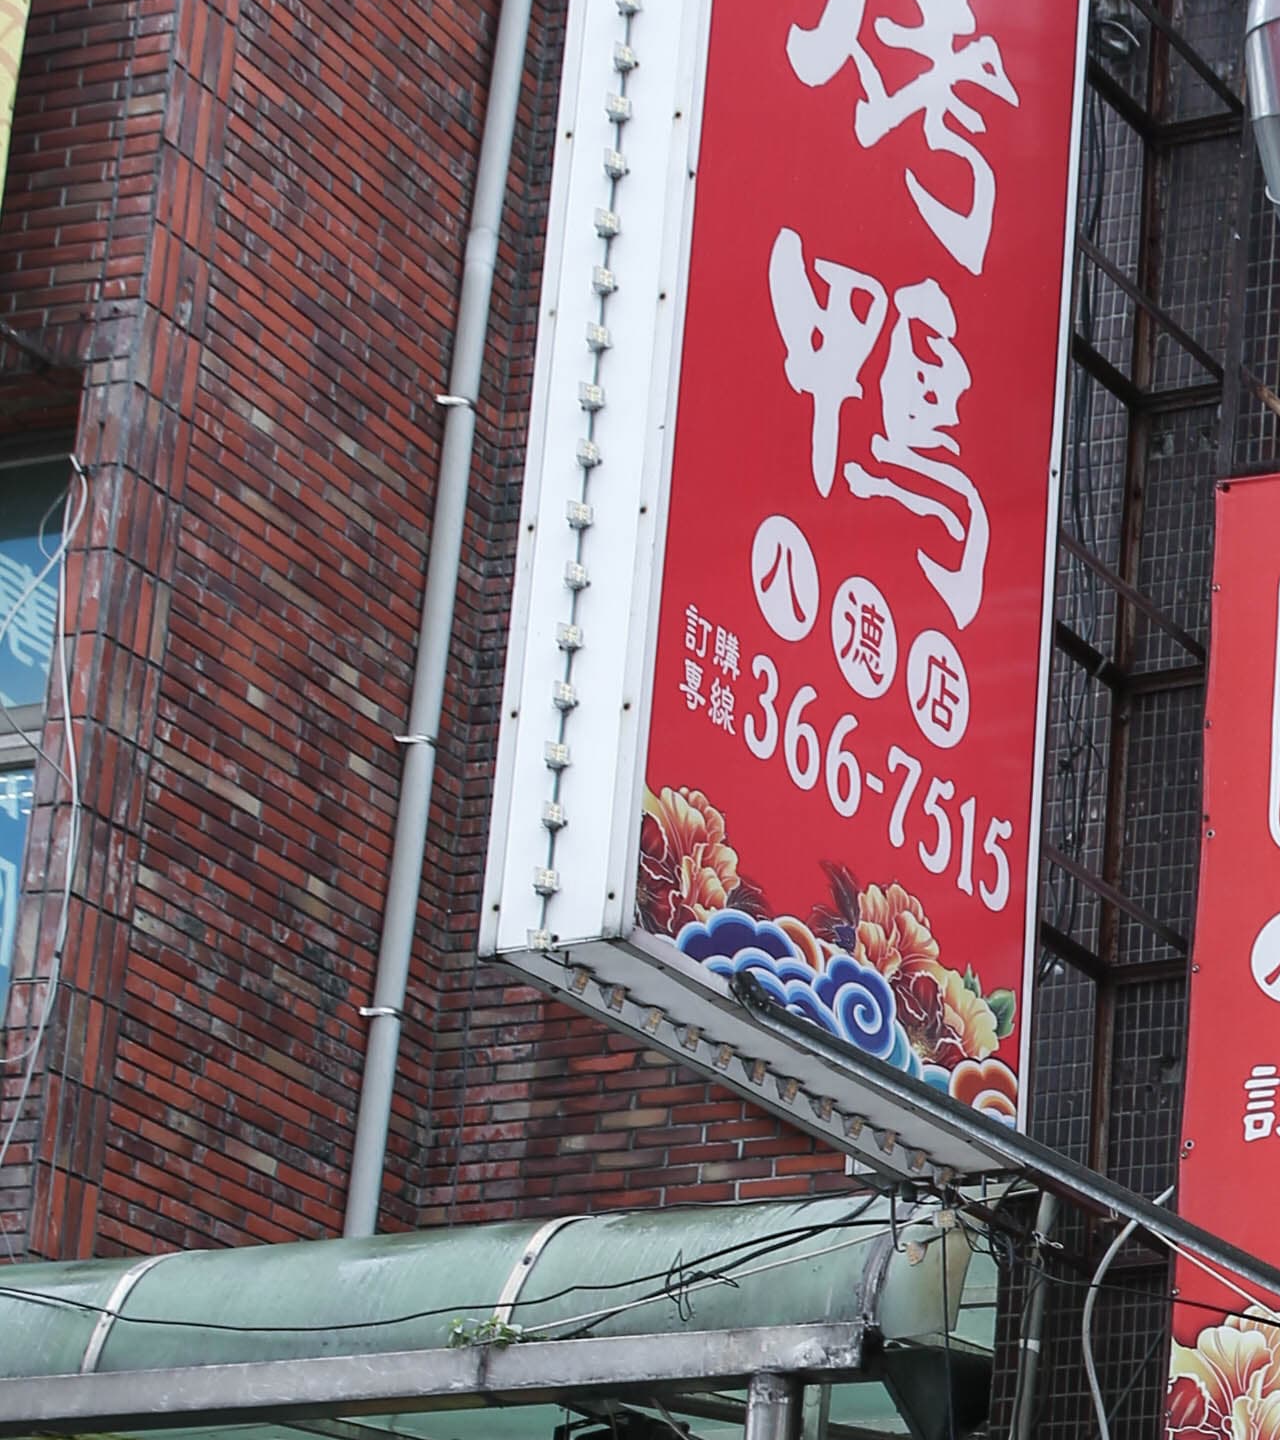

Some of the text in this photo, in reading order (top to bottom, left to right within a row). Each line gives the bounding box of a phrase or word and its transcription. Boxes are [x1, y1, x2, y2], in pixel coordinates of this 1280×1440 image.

[677, 658, 737, 736] 專線
[683, 604, 742, 680] 訂購
[760, 532, 962, 726] 八德店
[743, 653, 1012, 915] 366-7515
